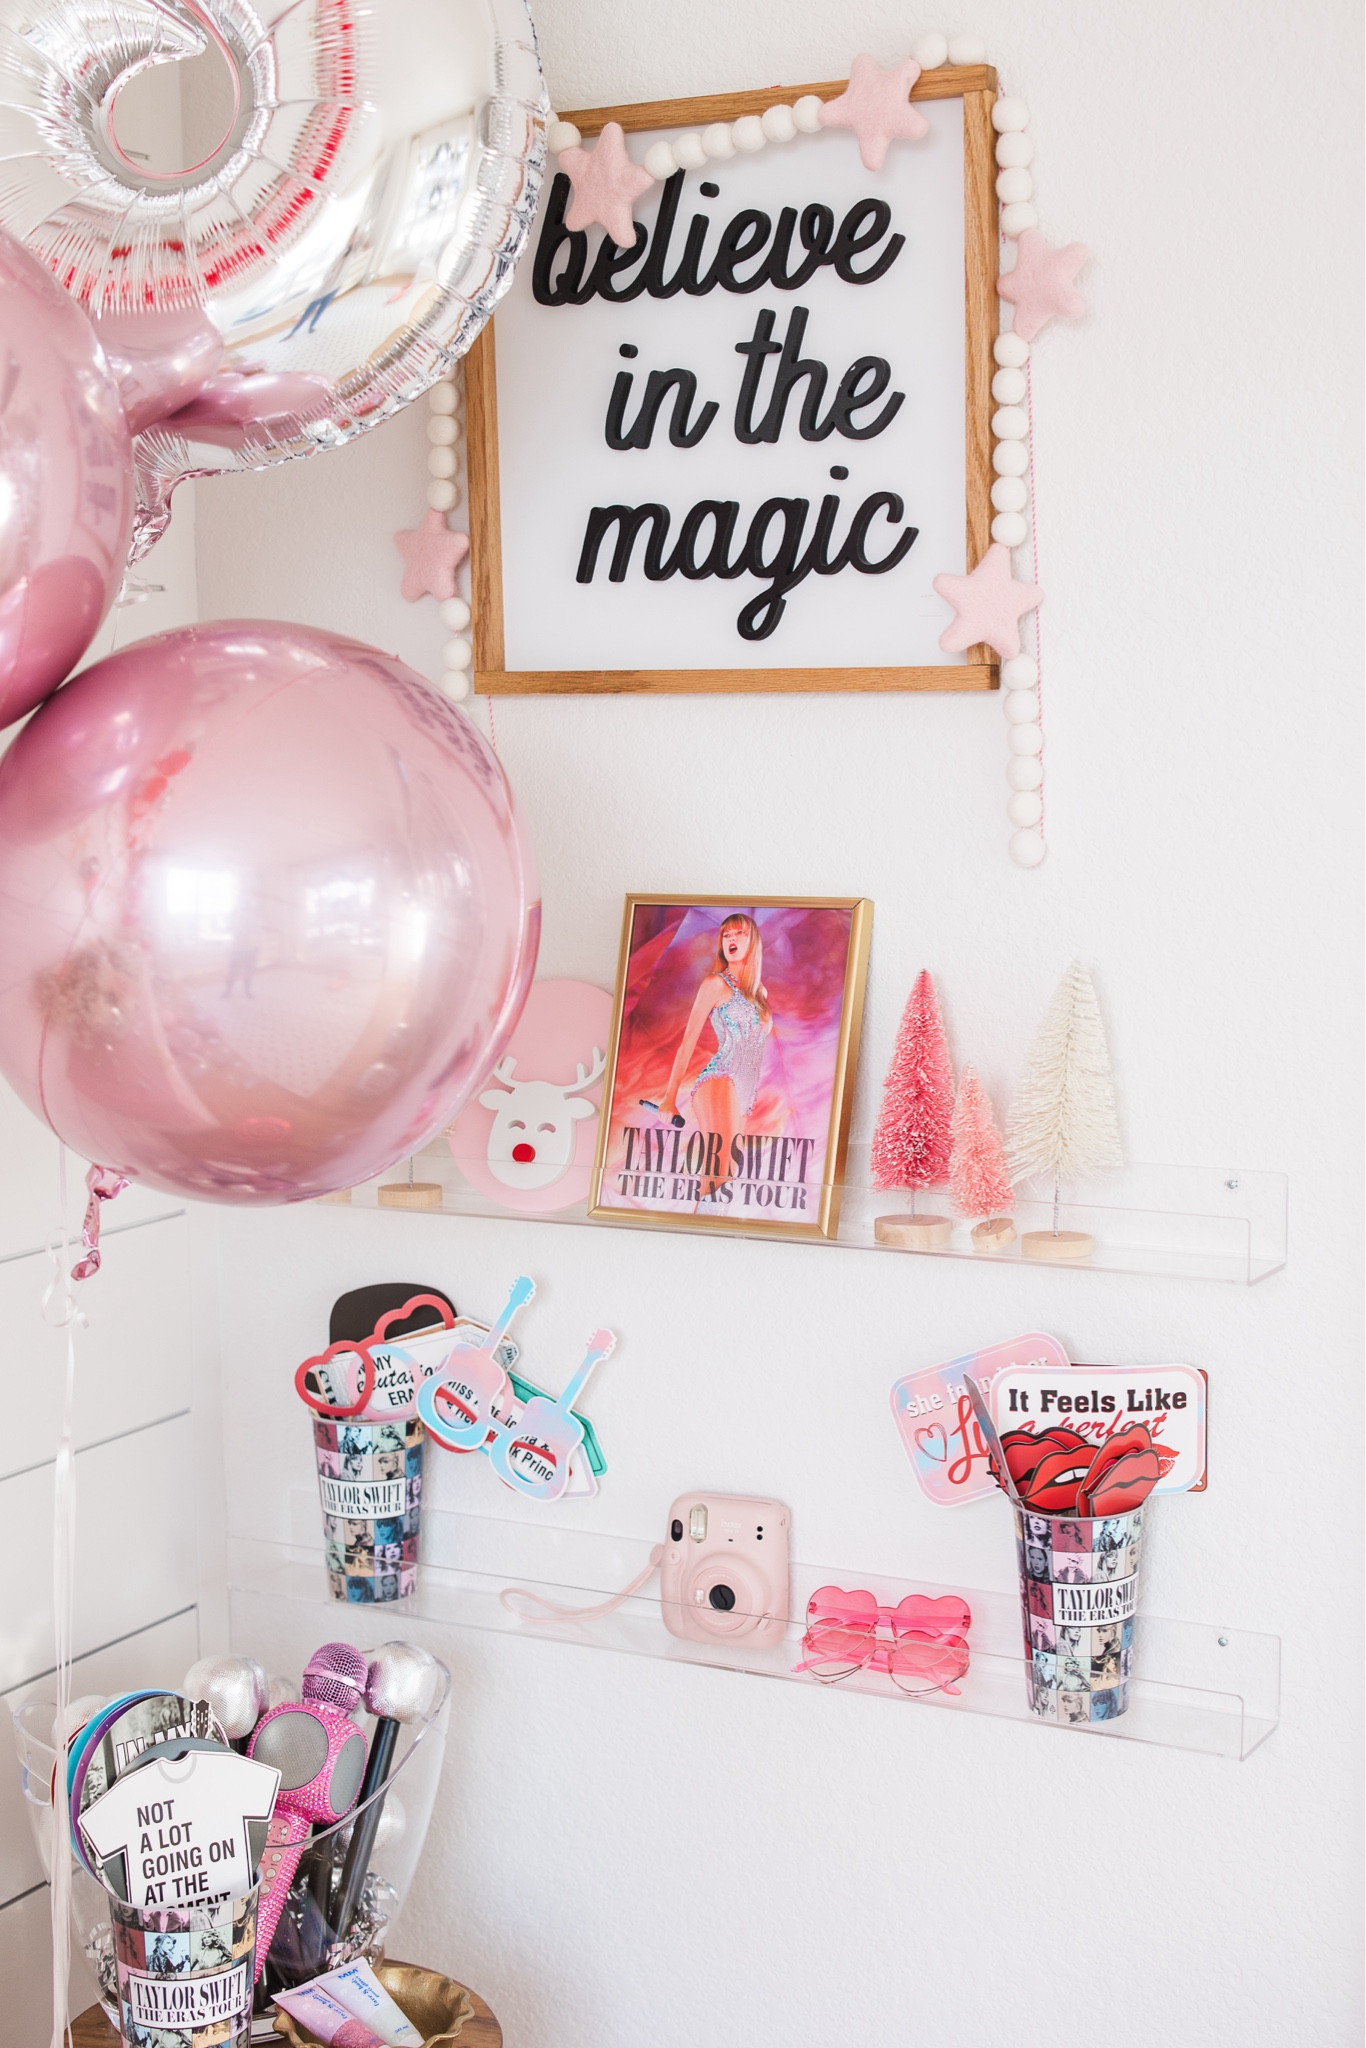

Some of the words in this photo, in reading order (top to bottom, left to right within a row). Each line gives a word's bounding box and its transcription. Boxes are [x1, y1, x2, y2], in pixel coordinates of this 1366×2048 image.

[532, 168, 906, 306] believe
[605, 343, 720, 451] in
[734, 306, 906, 445] the
[576, 465, 919, 641] magic
[623, 1126, 723, 1178] TAYLOR
[728, 1132, 815, 1184] SWIFT
[618, 1174, 665, 1199] THE
[671, 1178, 734, 1204] ERAS
[740, 1183, 807, 1210] TOUR
[906, 1392, 944, 1418] she
[1009, 1388, 1029, 1412] It
[1040, 1389, 1116, 1413] Feels
[1127, 1387, 1188, 1412] Like
[321, 1480, 360, 1504] TAYLOR
[363, 1482, 402, 1504] SWIFT
[341, 1503, 369, 1515] ERAS
[373, 1502, 401, 1514] TOUR
[1058, 1587, 1113, 1611] TAYLOR
[1059, 1609, 1086, 1621] THE
[1090, 1606, 1120, 1621] ERAS
[137, 1799, 175, 1828] NOT
[140, 1832, 153, 1854] A
[158, 1821, 193, 1849] LOT
[142, 1846, 203, 1879] GOING
[208, 1838, 235, 1863] ON
[144, 1881, 167, 1906] AT
[172, 1870, 209, 1898] THE
[133, 1981, 195, 2010] TAYLOR
[199, 1969, 243, 2007] SWIFT
[136, 2006, 163, 2023] THE
[167, 2008, 205, 2023] ERAS
[208, 1994, 242, 2018] TOUR
